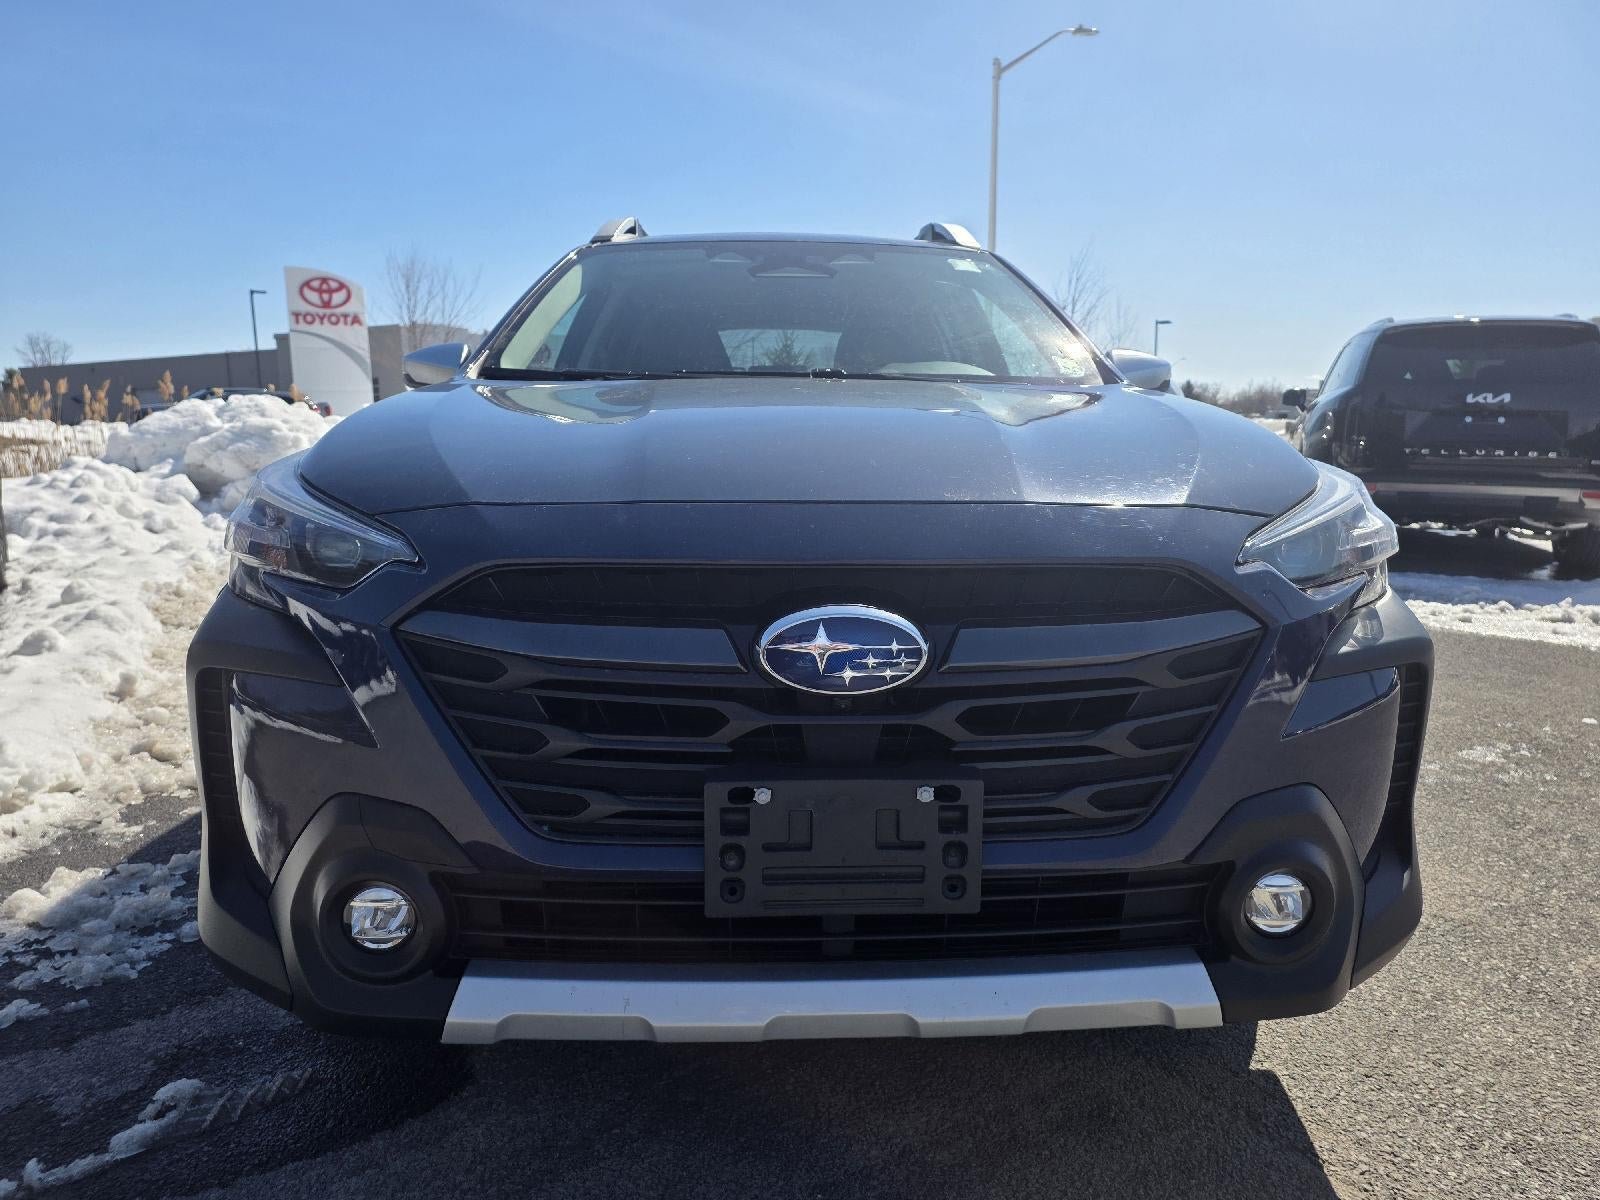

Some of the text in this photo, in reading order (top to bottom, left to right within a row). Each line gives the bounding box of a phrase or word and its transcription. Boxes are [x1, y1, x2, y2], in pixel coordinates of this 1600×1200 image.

[291, 312, 363, 327] TOYOTA
[1466, 392, 1511, 403] KIA
[1404, 448, 1557, 459] TELLURIDE
